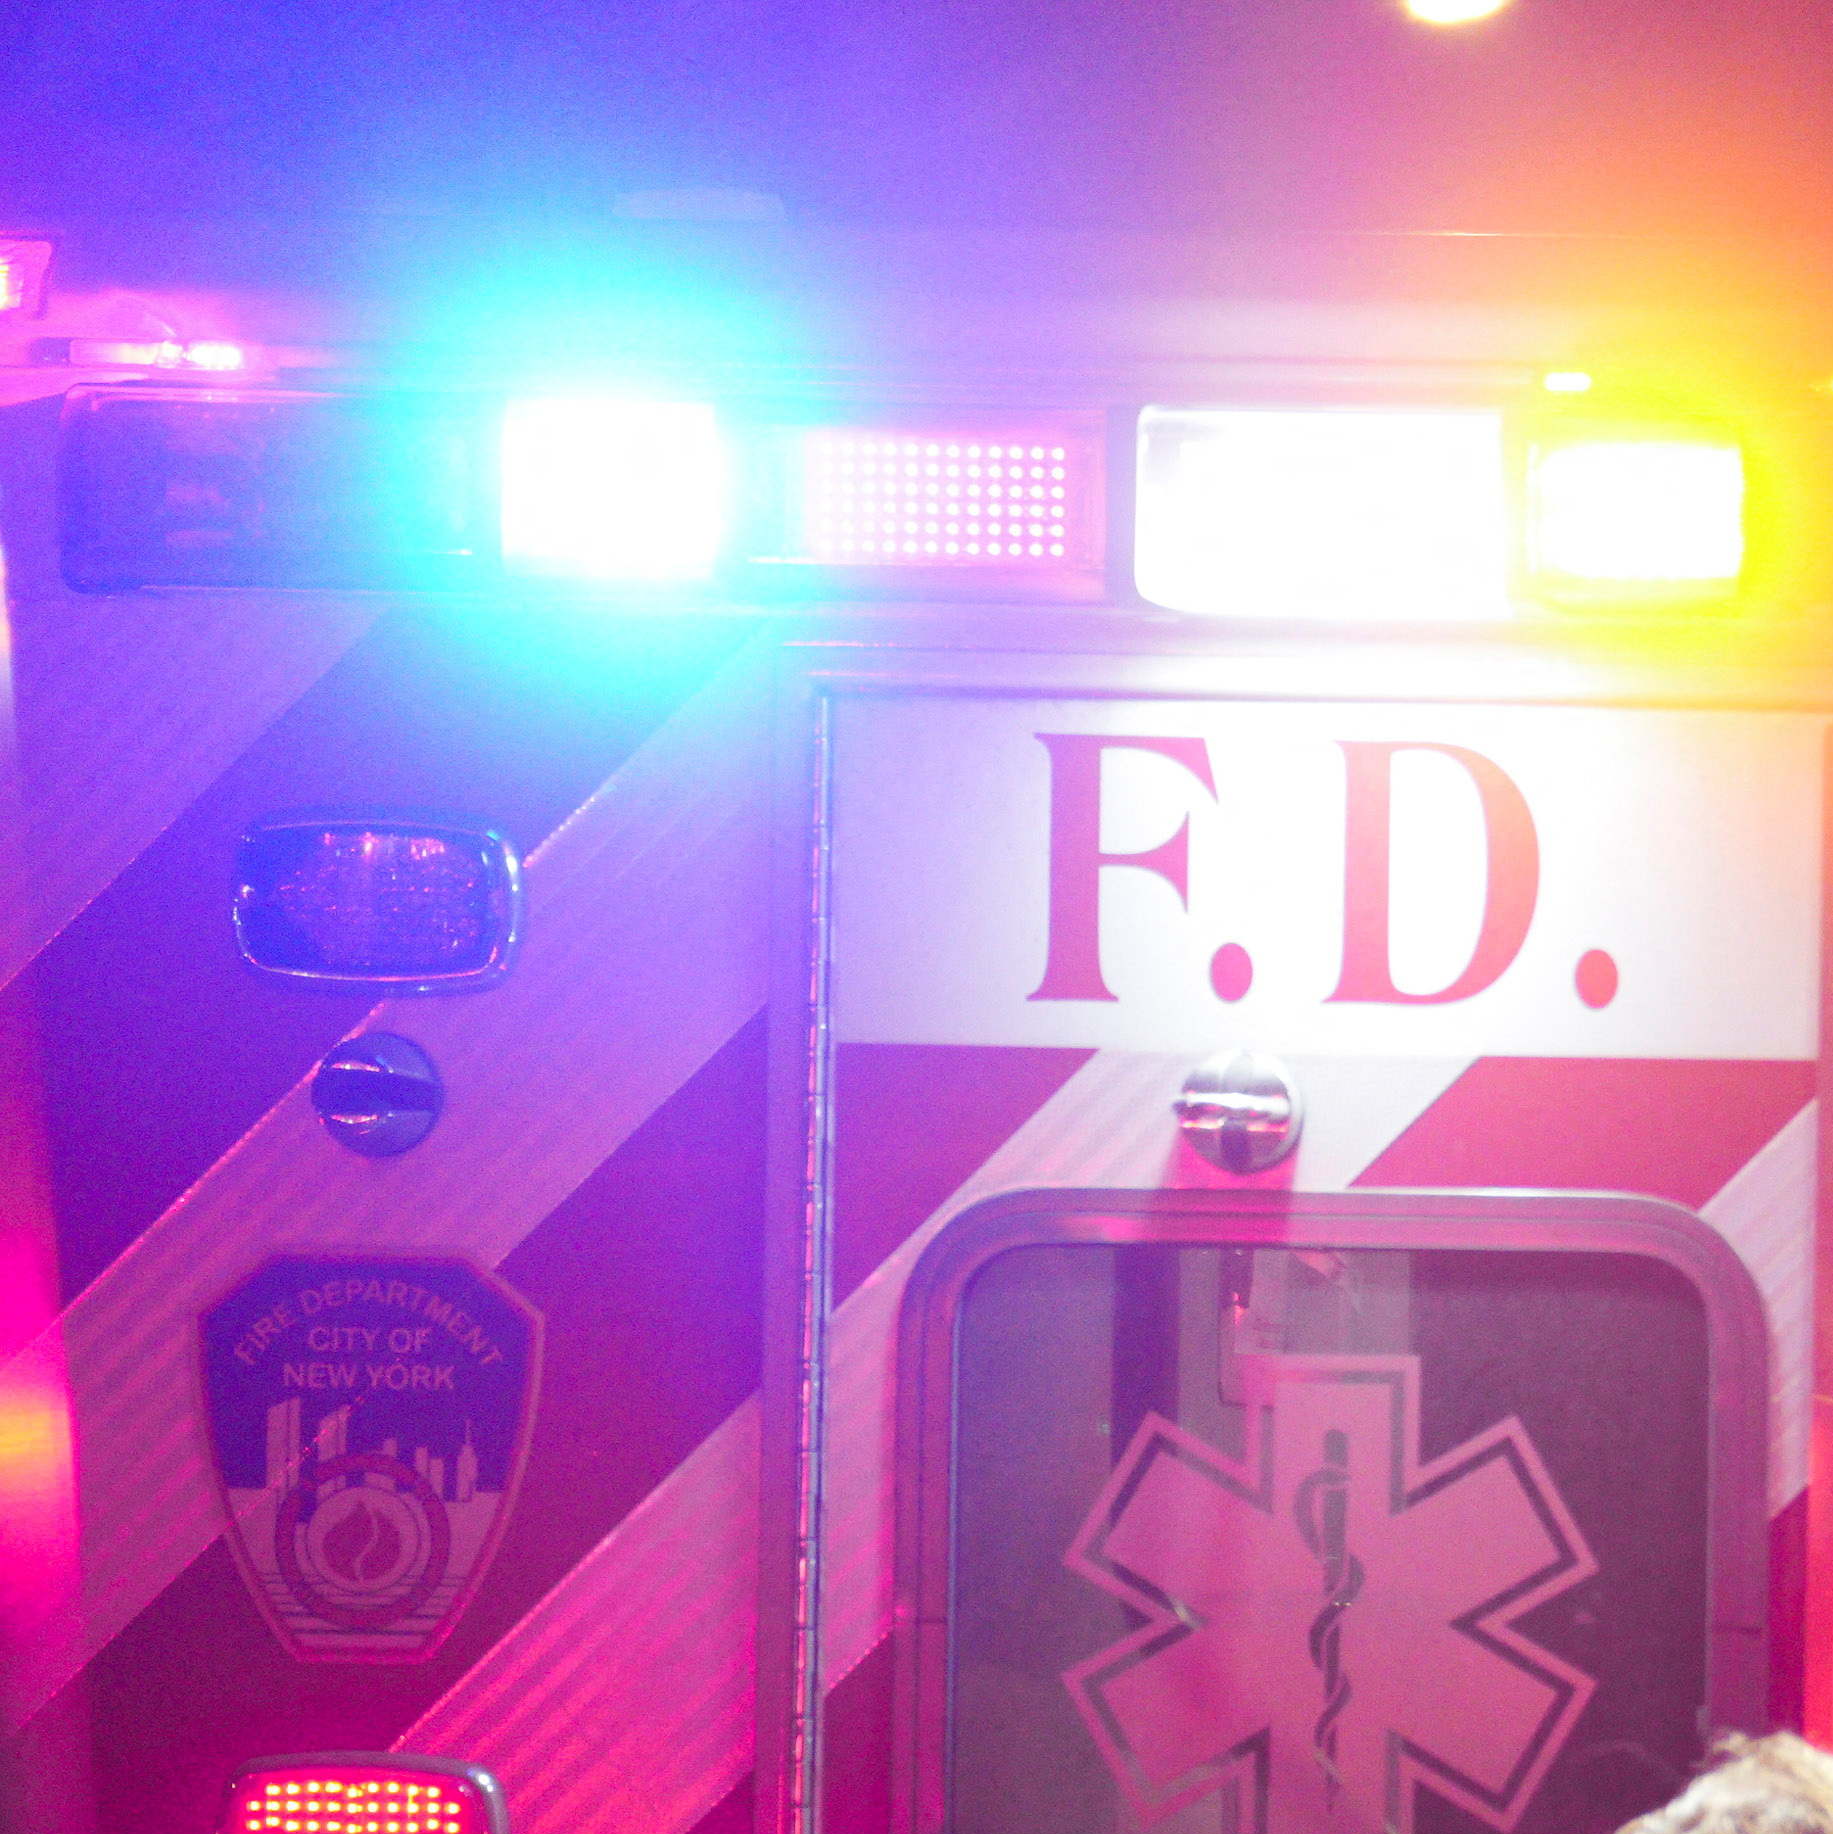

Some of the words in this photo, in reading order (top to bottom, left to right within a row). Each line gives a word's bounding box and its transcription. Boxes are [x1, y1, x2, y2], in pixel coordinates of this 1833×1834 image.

[1026, 732, 1619, 1010] F.D.
[234, 1303, 297, 1365] FIRE
[300, 1279, 503, 1364] DEPARTMENT
[308, 1326, 382, 1351] CITY
[389, 1327, 432, 1353] OF
[283, 1361, 357, 1389] NEW
[365, 1363, 454, 1391] YORK
